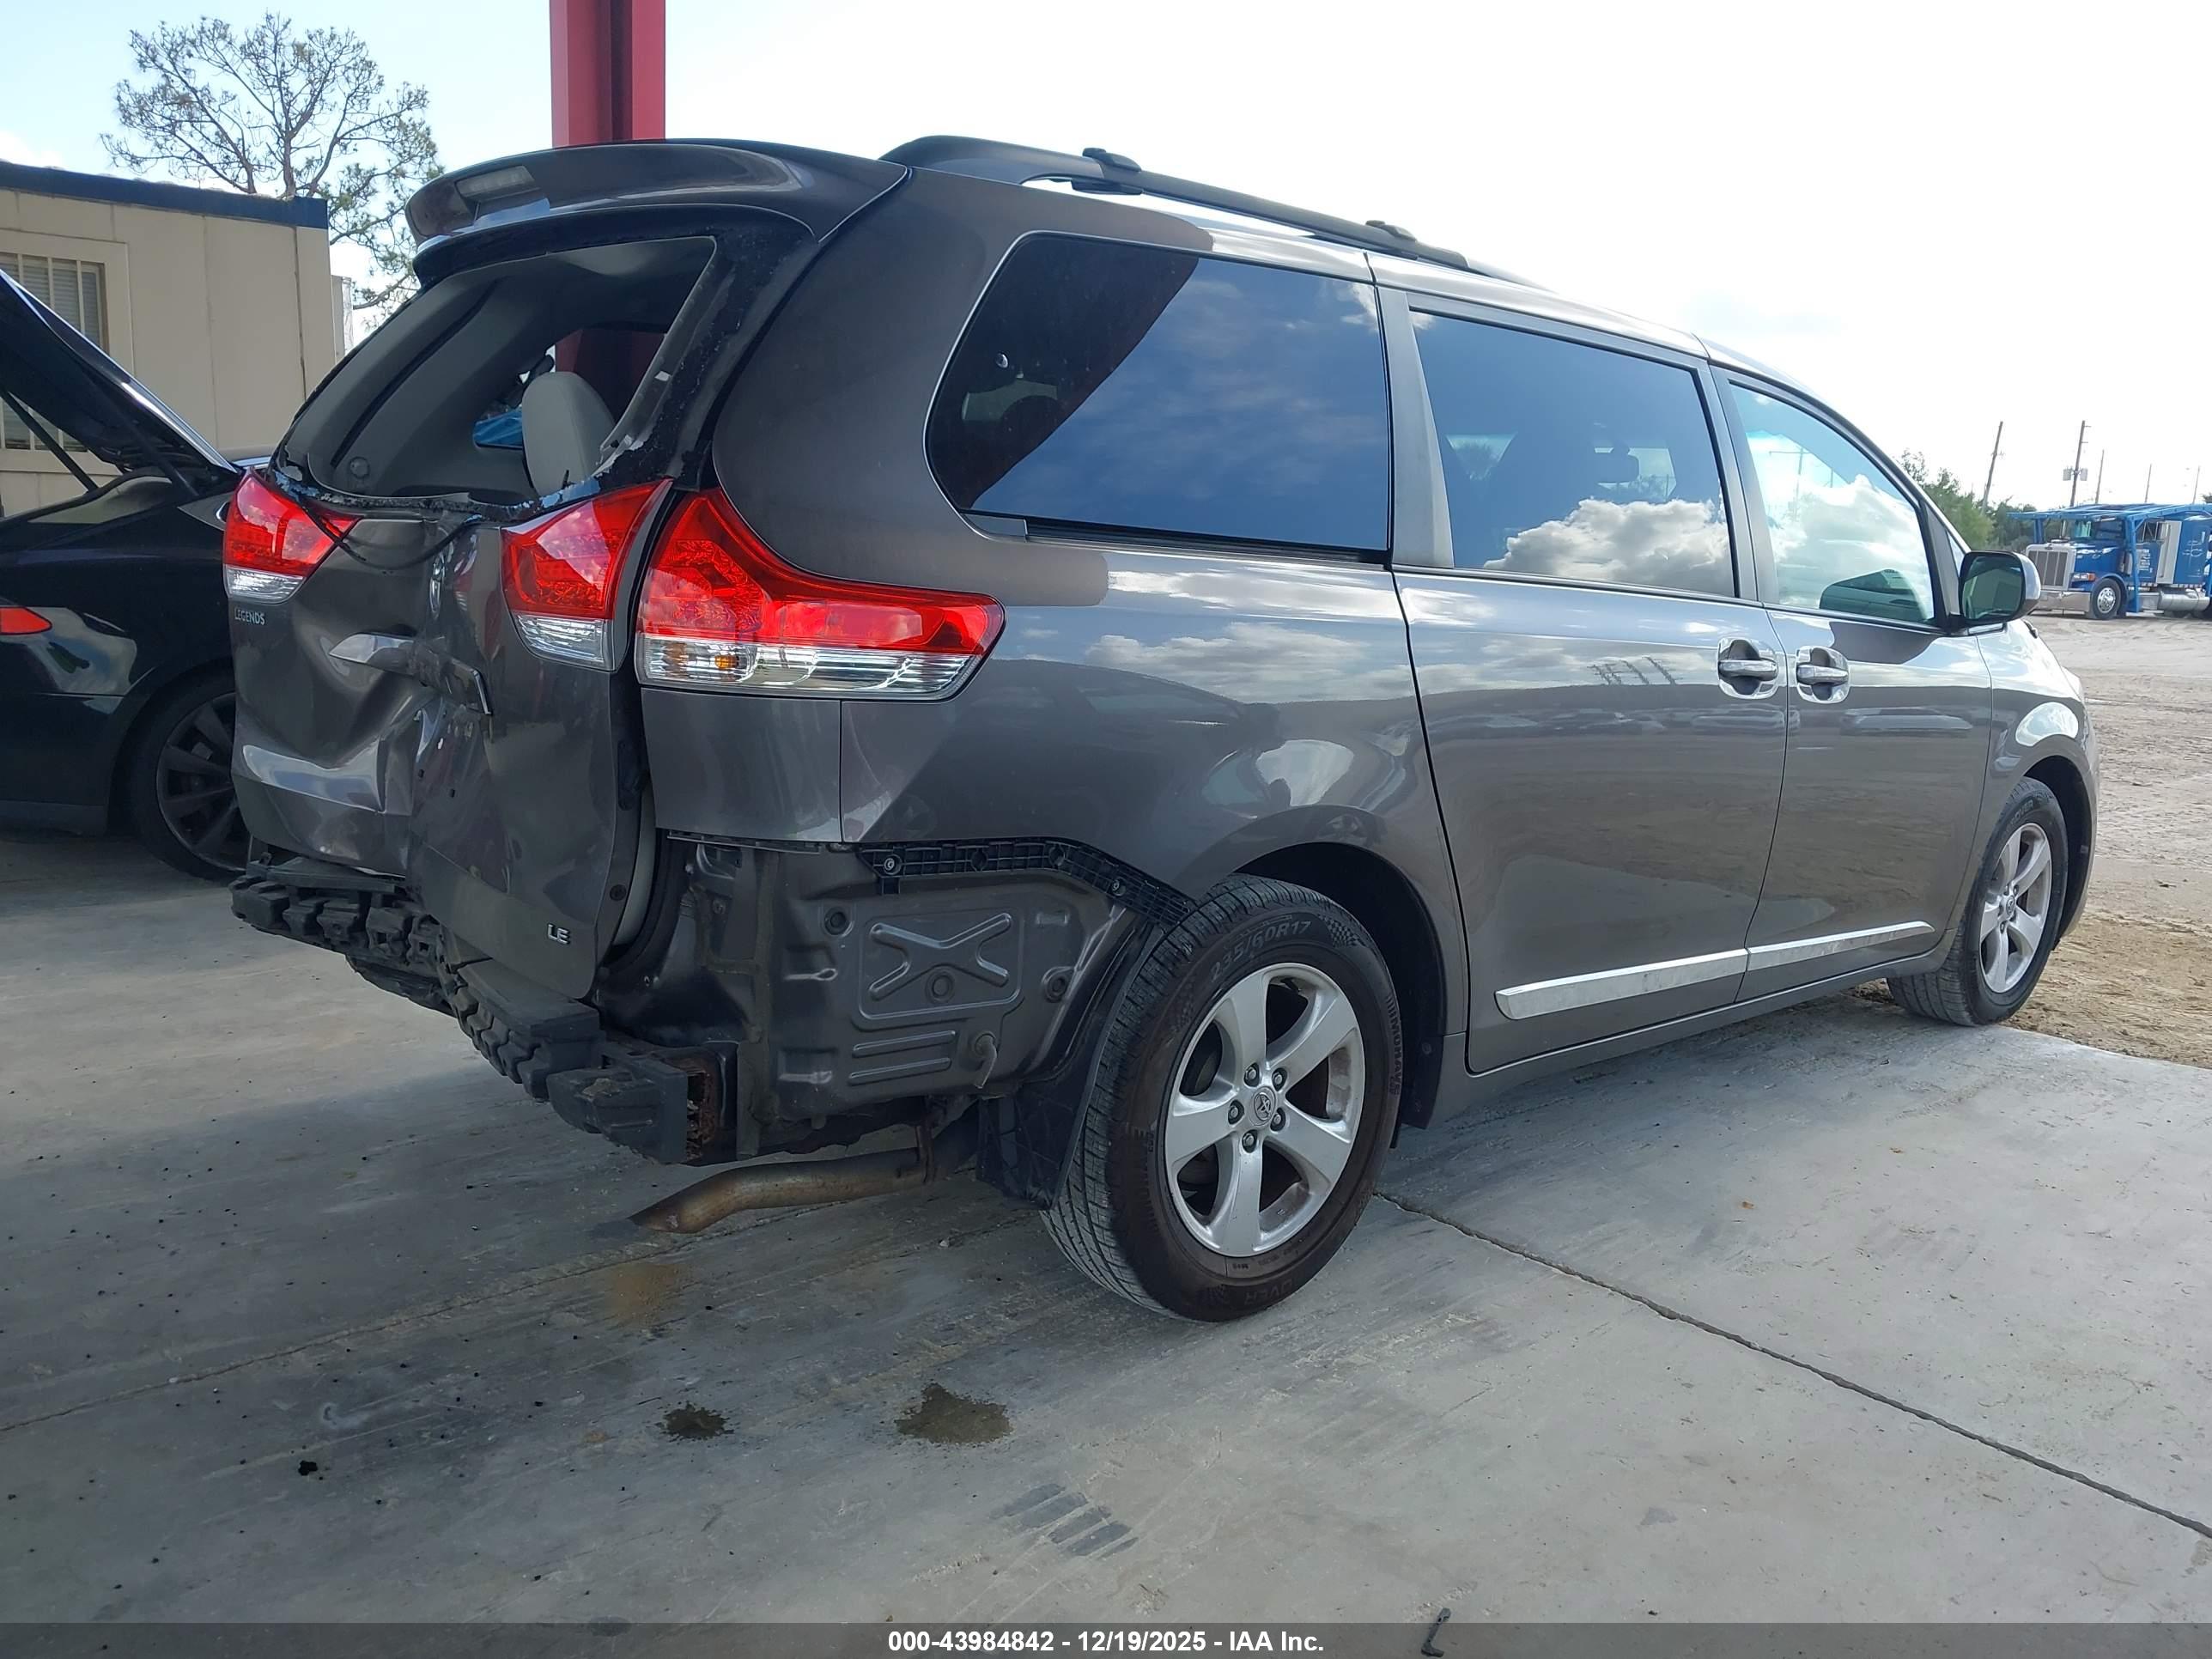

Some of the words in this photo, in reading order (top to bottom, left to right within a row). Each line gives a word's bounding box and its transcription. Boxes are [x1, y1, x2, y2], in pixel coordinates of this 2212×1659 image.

[234, 606, 265, 625] LEGENDS
[547, 923, 568, 945] LE
[1210, 920, 1312, 981] 235/60R17
